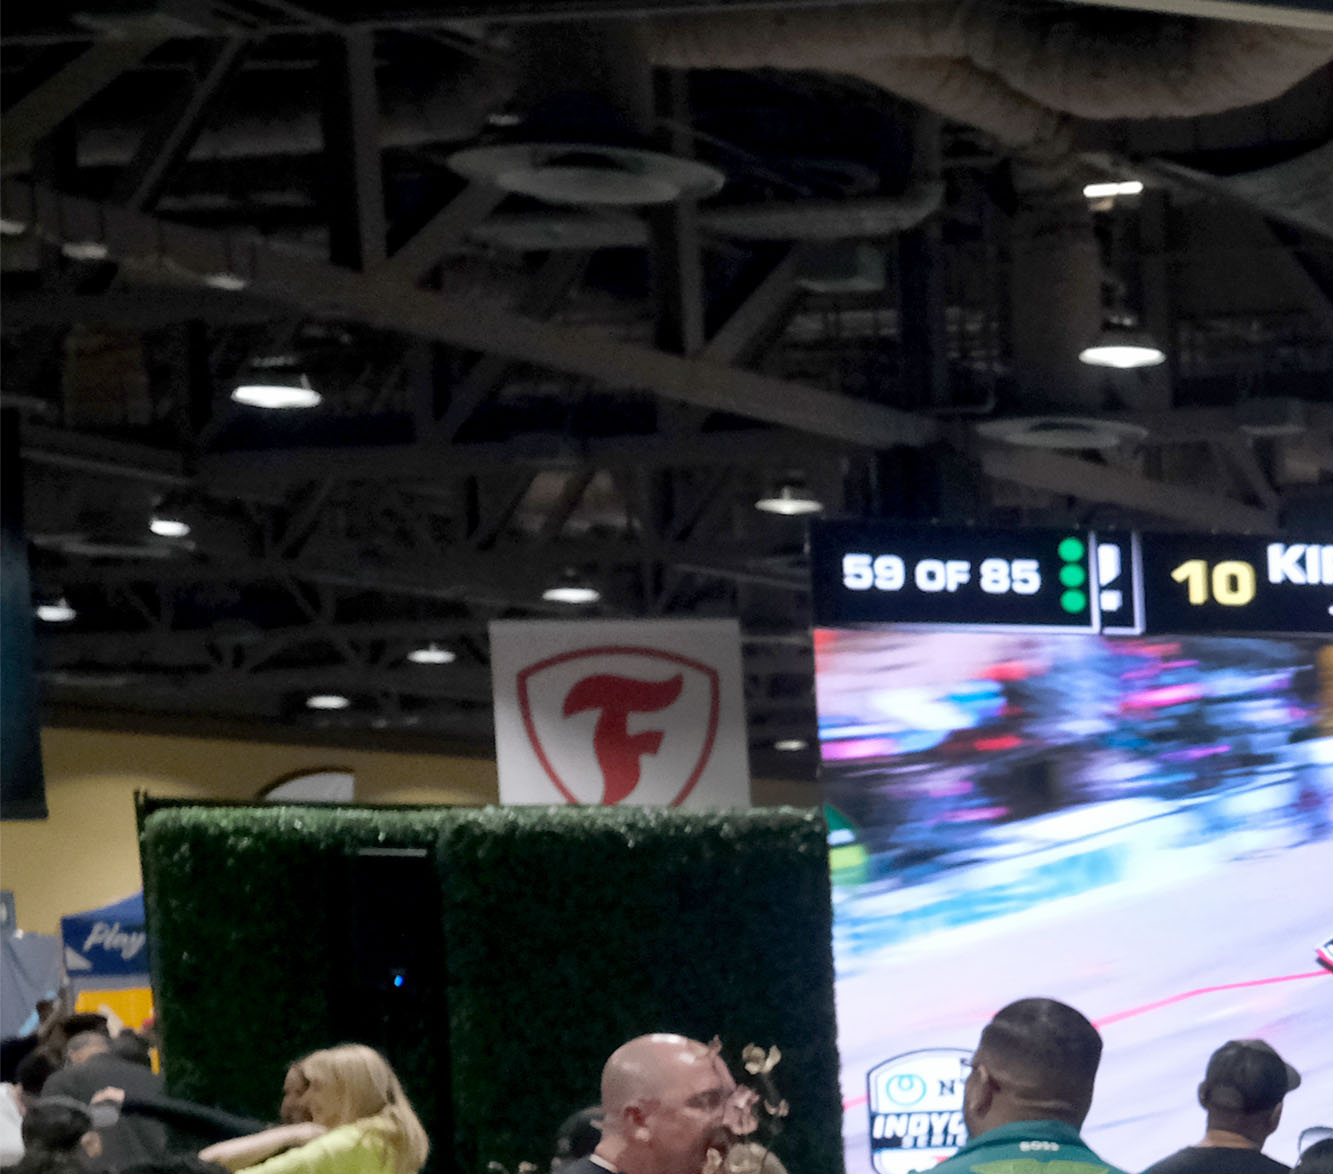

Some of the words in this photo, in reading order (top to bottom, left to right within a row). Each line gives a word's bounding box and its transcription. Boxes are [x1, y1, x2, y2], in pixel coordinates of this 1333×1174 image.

[842, 553, 905, 592] 59
[915, 560, 971, 594] OF
[980, 558, 1042, 595] 85
[1171, 559, 1257, 607] 10
